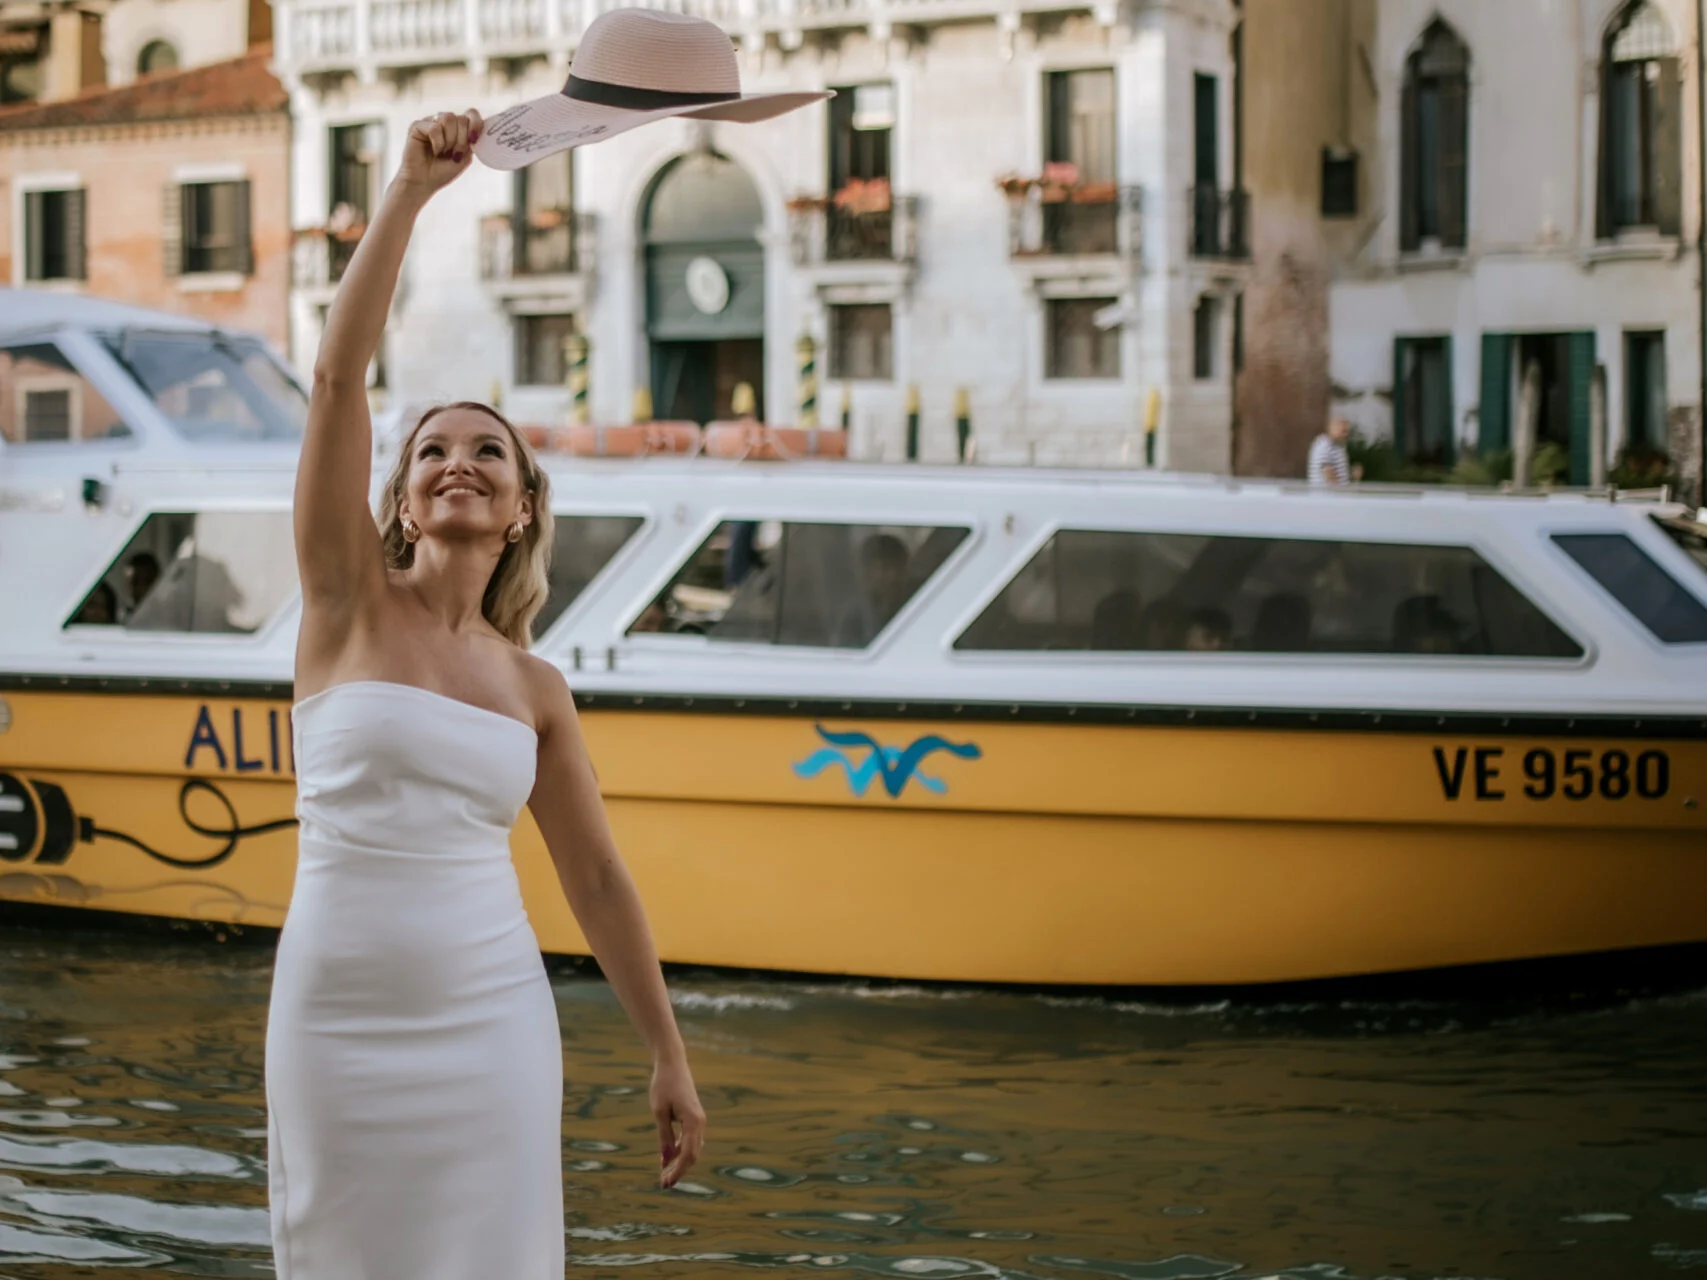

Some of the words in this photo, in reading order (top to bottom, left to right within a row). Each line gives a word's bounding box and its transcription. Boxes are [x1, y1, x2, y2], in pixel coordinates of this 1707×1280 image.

[184, 704, 295, 773] ALI
[1432, 746, 1505, 802] VE
[1522, 747, 1671, 801] 9580
